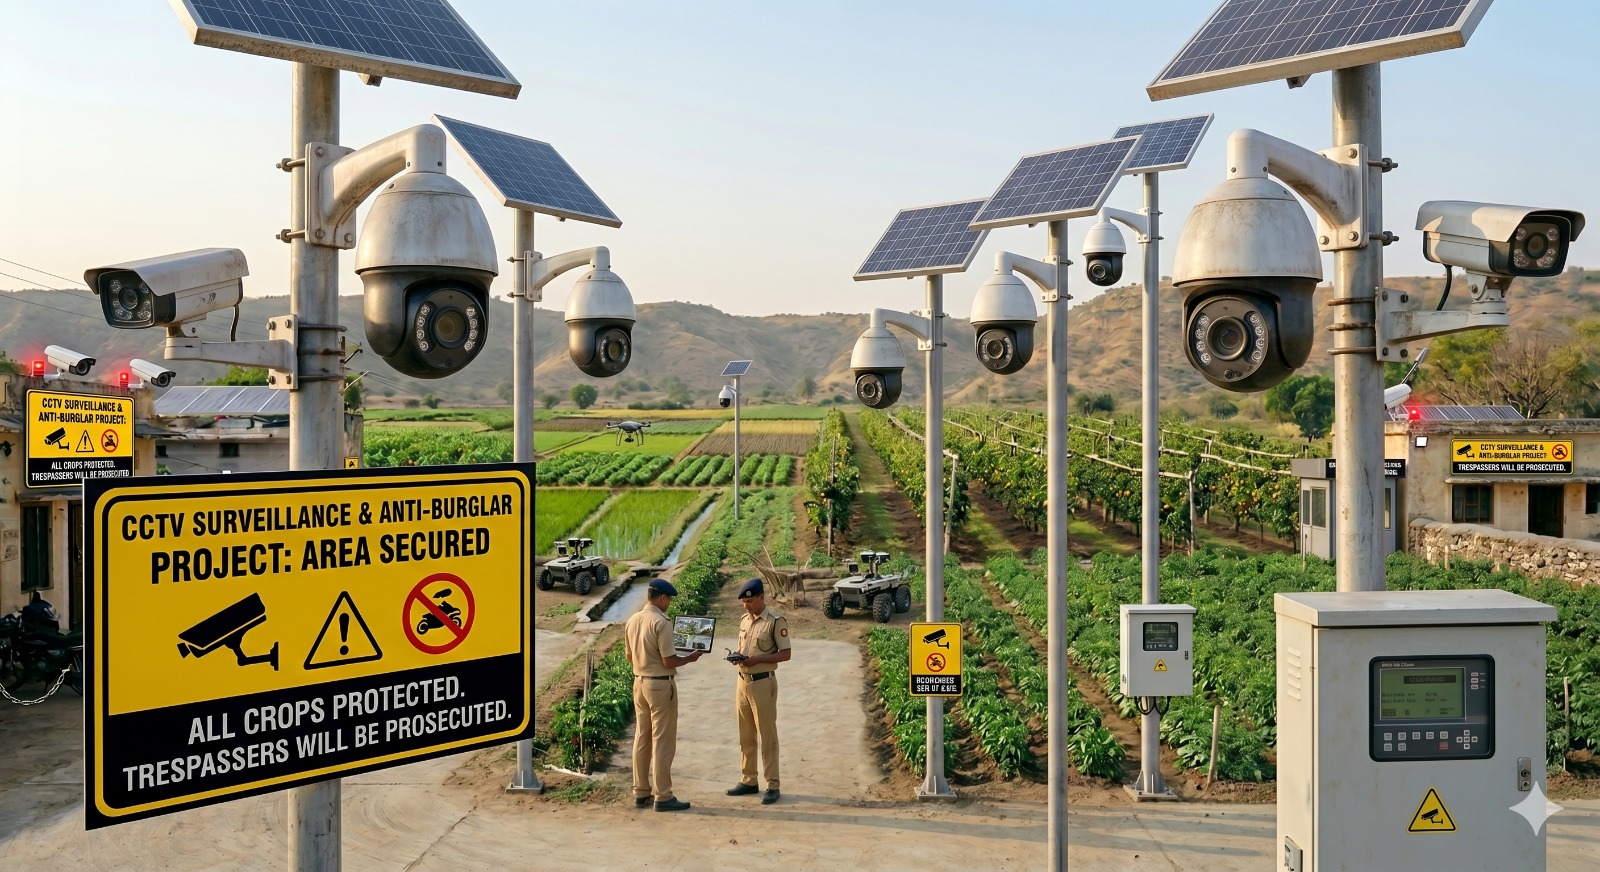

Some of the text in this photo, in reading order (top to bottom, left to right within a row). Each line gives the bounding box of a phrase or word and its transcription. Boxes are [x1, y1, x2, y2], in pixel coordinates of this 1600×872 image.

[39, 412, 126, 424] ANTI-BURGLAR PROJECT:
[42, 398, 122, 412] CCTV SURVEILLANCE &
[122, 494, 512, 541] CCTV SURVEILLANCE & ANTI-BURGLAR
[151, 527, 489, 584] PROJECT: AREA SECURED
[188, 676, 465, 745] ALL CROPS PROTECTED.
[123, 699, 511, 791] TRESPASSERS WILL BE PROSECUTED.
